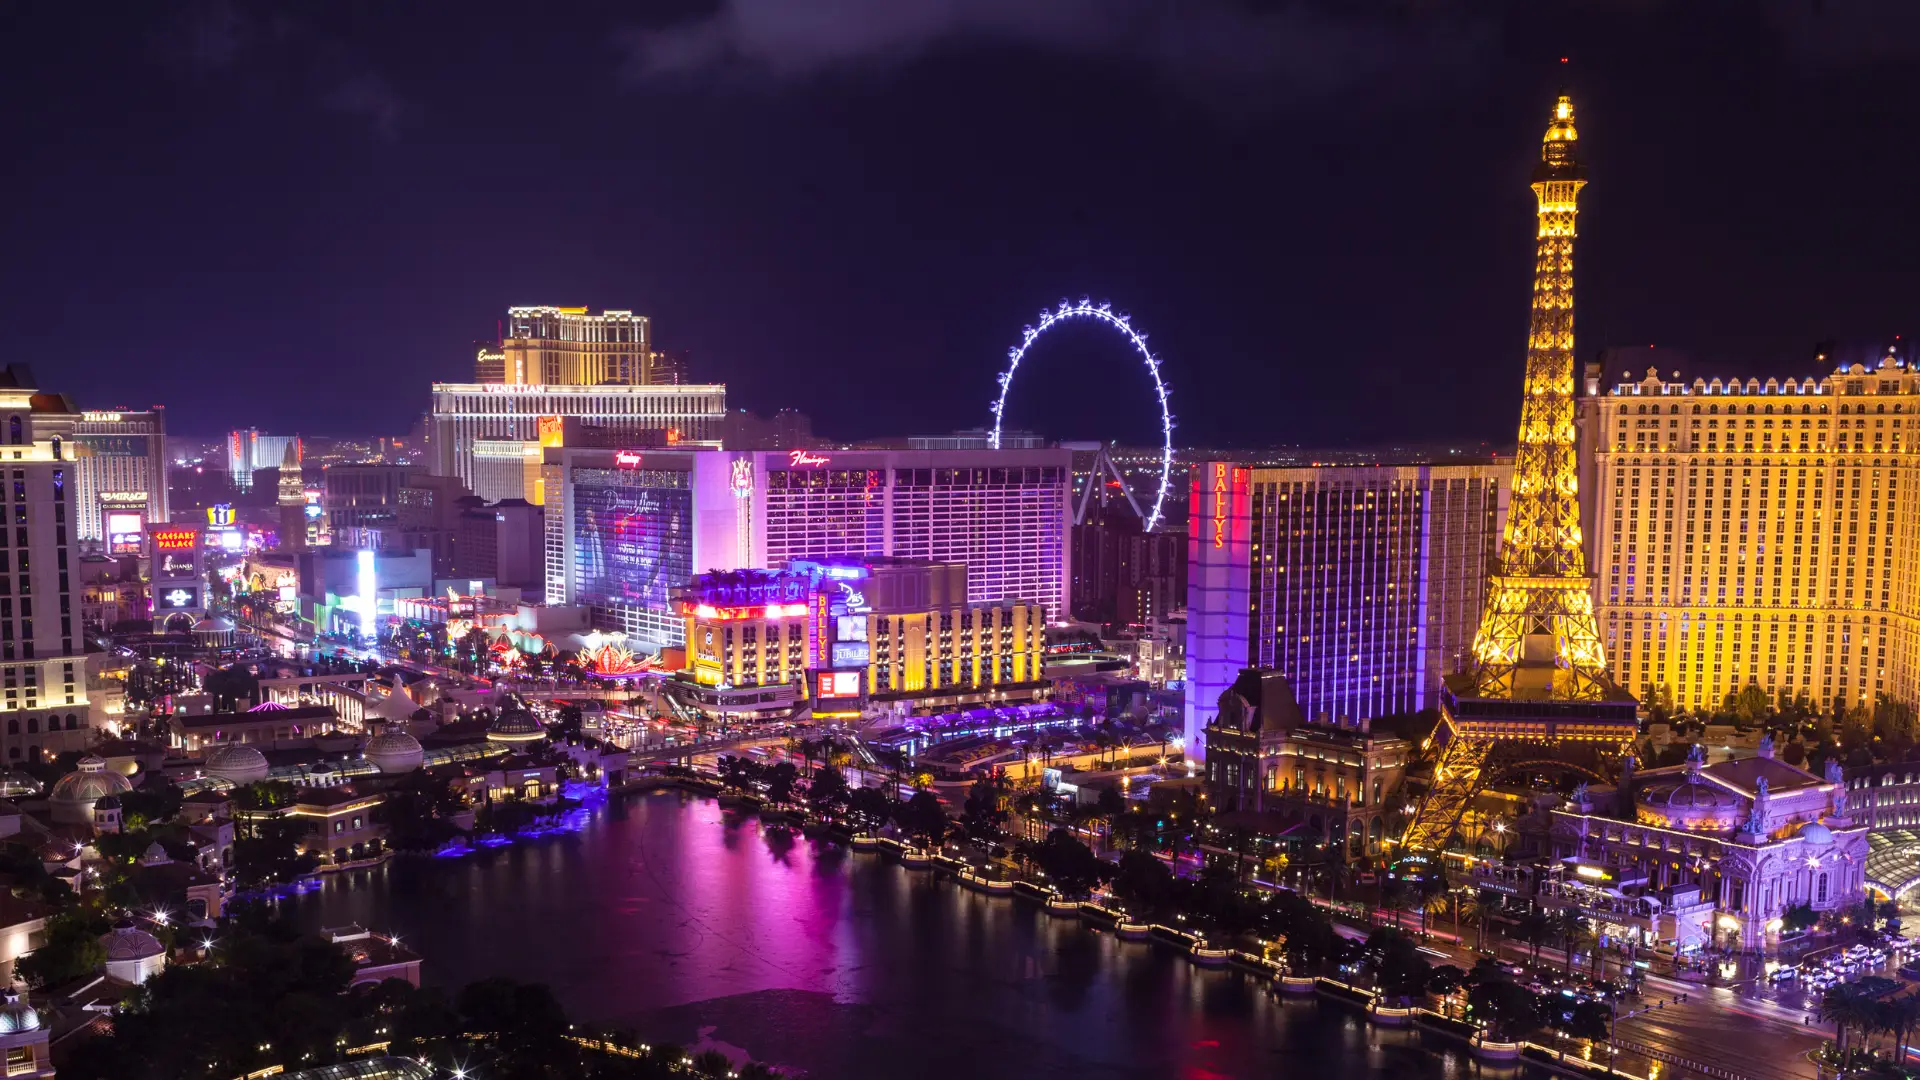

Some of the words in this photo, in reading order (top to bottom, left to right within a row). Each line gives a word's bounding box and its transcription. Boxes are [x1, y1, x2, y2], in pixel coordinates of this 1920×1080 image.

[485, 384, 545, 393] VENETIAN
[84, 413, 121, 421] ISLAND
[790, 450, 830, 467] Flamingo
[110, 491, 148, 502] MIRAGE
[155, 531, 195, 540] CAESARS
[159, 540, 194, 548] PALACE
[1495, 885, 1518, 894] FACTORY
[1597, 912, 1622, 922] FACTORY
